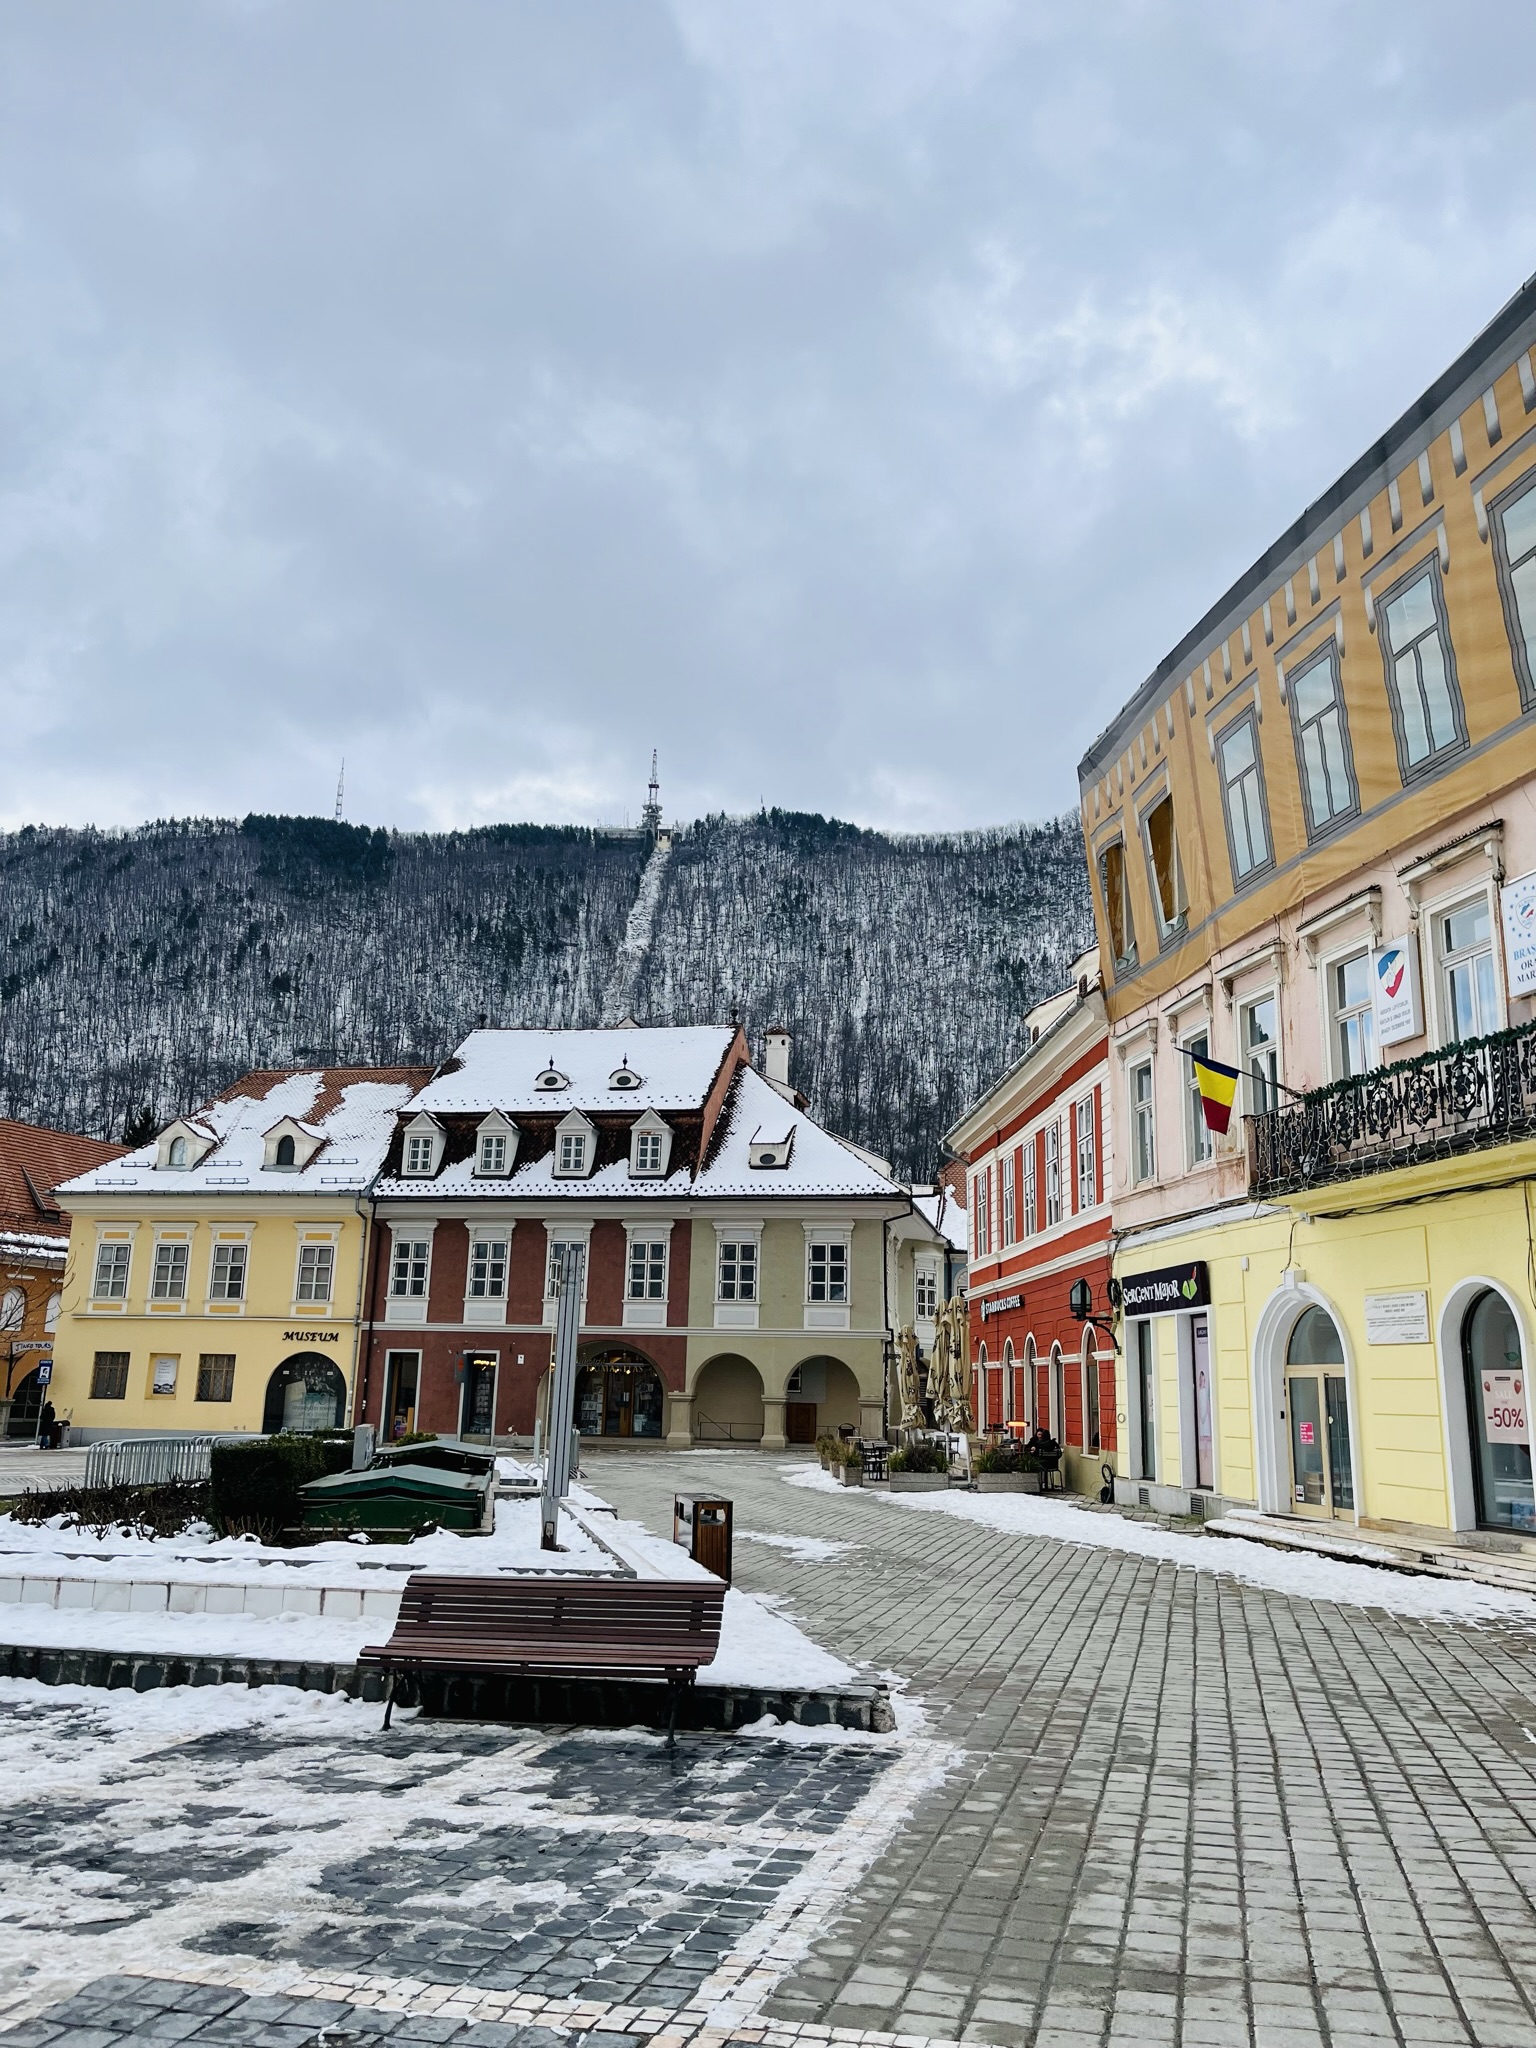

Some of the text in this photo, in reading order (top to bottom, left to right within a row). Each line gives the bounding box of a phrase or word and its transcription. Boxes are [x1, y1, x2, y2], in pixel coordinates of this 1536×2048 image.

[985, 1294, 1021, 1315] STARBUCKS COFFEE
[282, 1331, 339, 1342] MUSEUM
[1487, 1407, 1524, 1428] -50%
